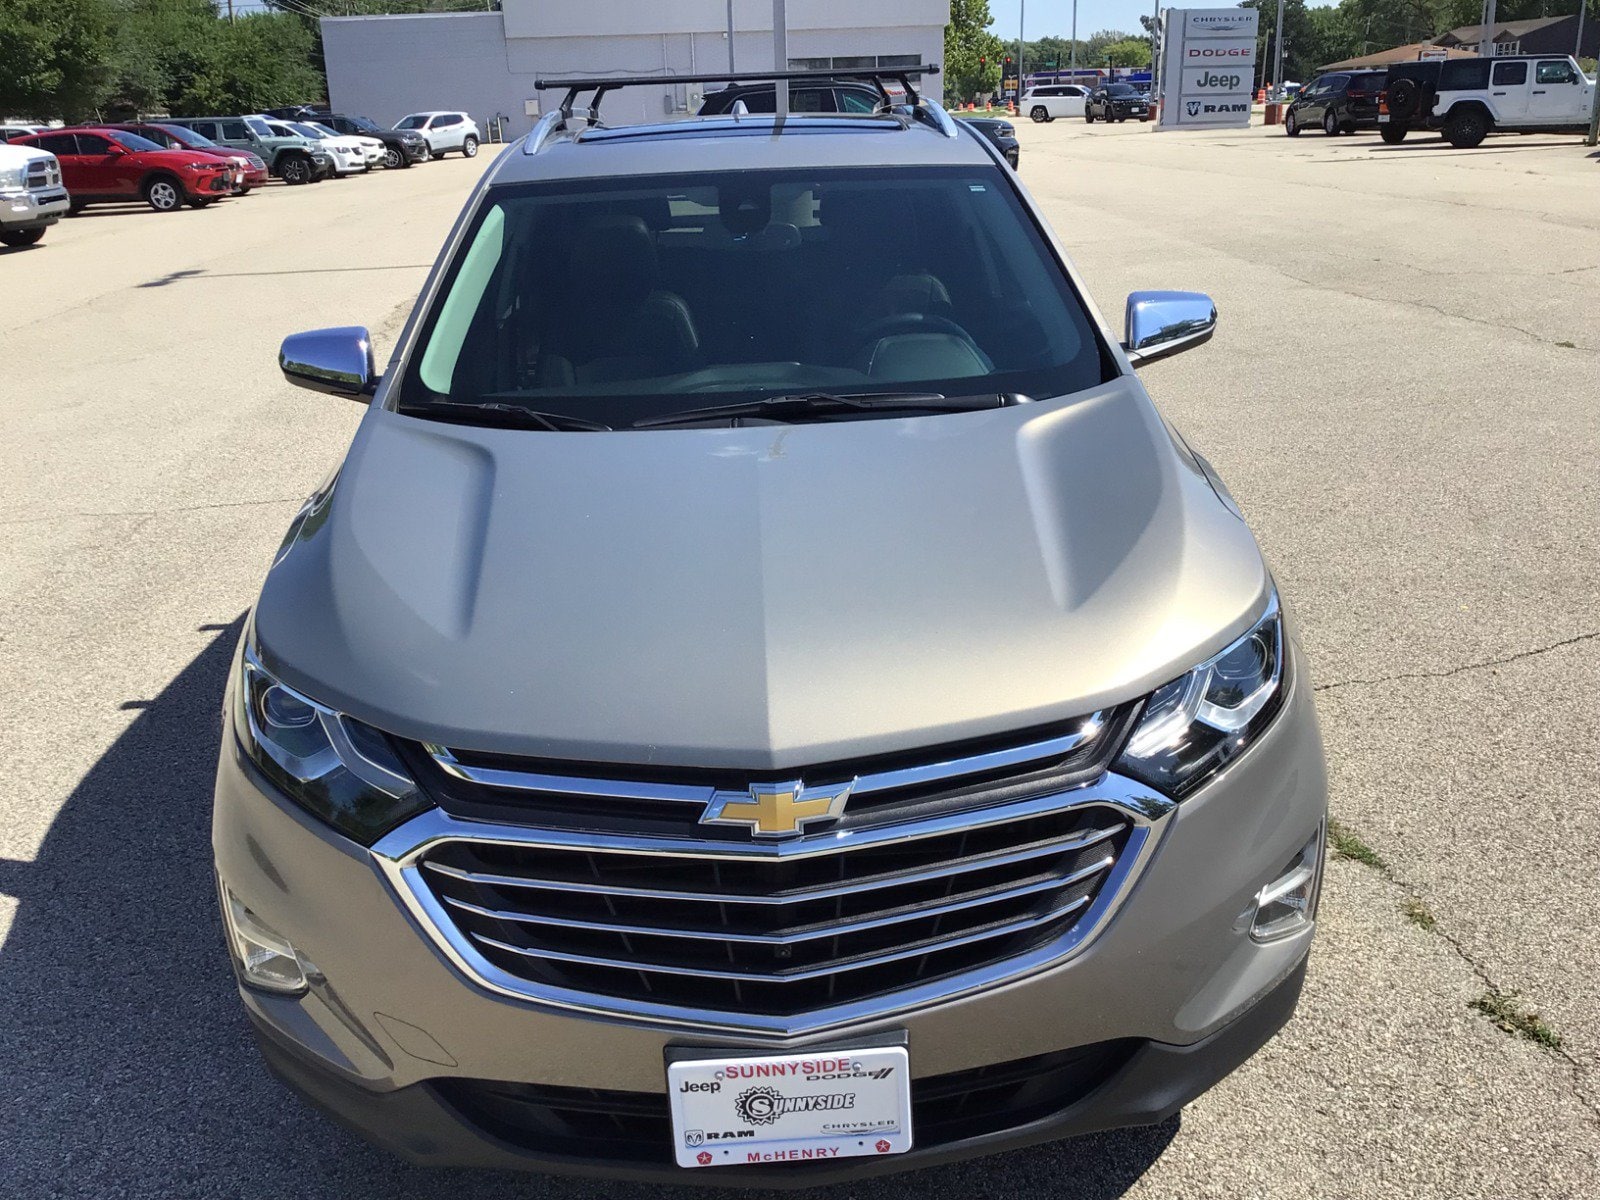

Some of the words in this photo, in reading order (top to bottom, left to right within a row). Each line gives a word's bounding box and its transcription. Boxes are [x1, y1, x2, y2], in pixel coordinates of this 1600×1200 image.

[1189, 48, 1251, 57] DODGE
[1196, 72, 1240, 90] Jeep
[1204, 104, 1247, 112] RAM
[726, 1058, 850, 1079] SUNNYSIDE
[680, 1081, 721, 1093] Jeep
[822, 1120, 895, 1130] CHRYSLER
[706, 1130, 754, 1140] RAM
[747, 1147, 840, 1162] McHENRY
